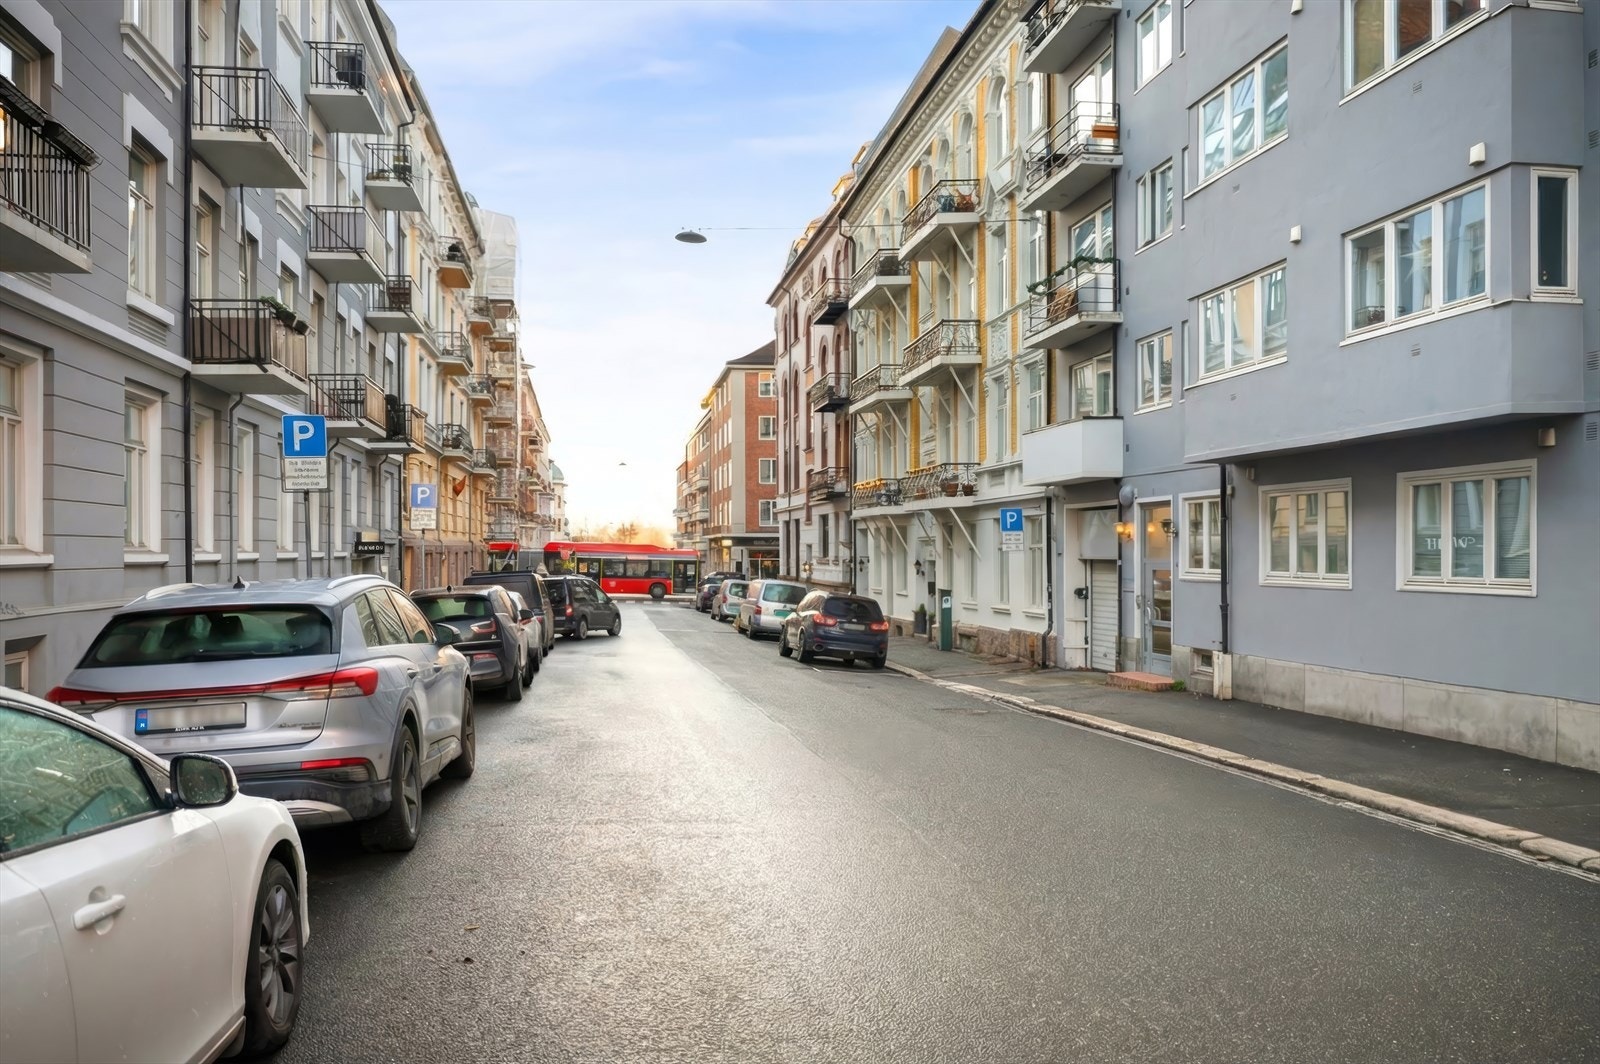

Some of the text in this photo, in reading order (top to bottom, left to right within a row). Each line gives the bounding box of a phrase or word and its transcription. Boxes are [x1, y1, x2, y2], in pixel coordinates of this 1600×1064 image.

[292, 420, 315, 452] P
[417, 487, 430, 504] P
[1006, 511, 1017, 529] P
